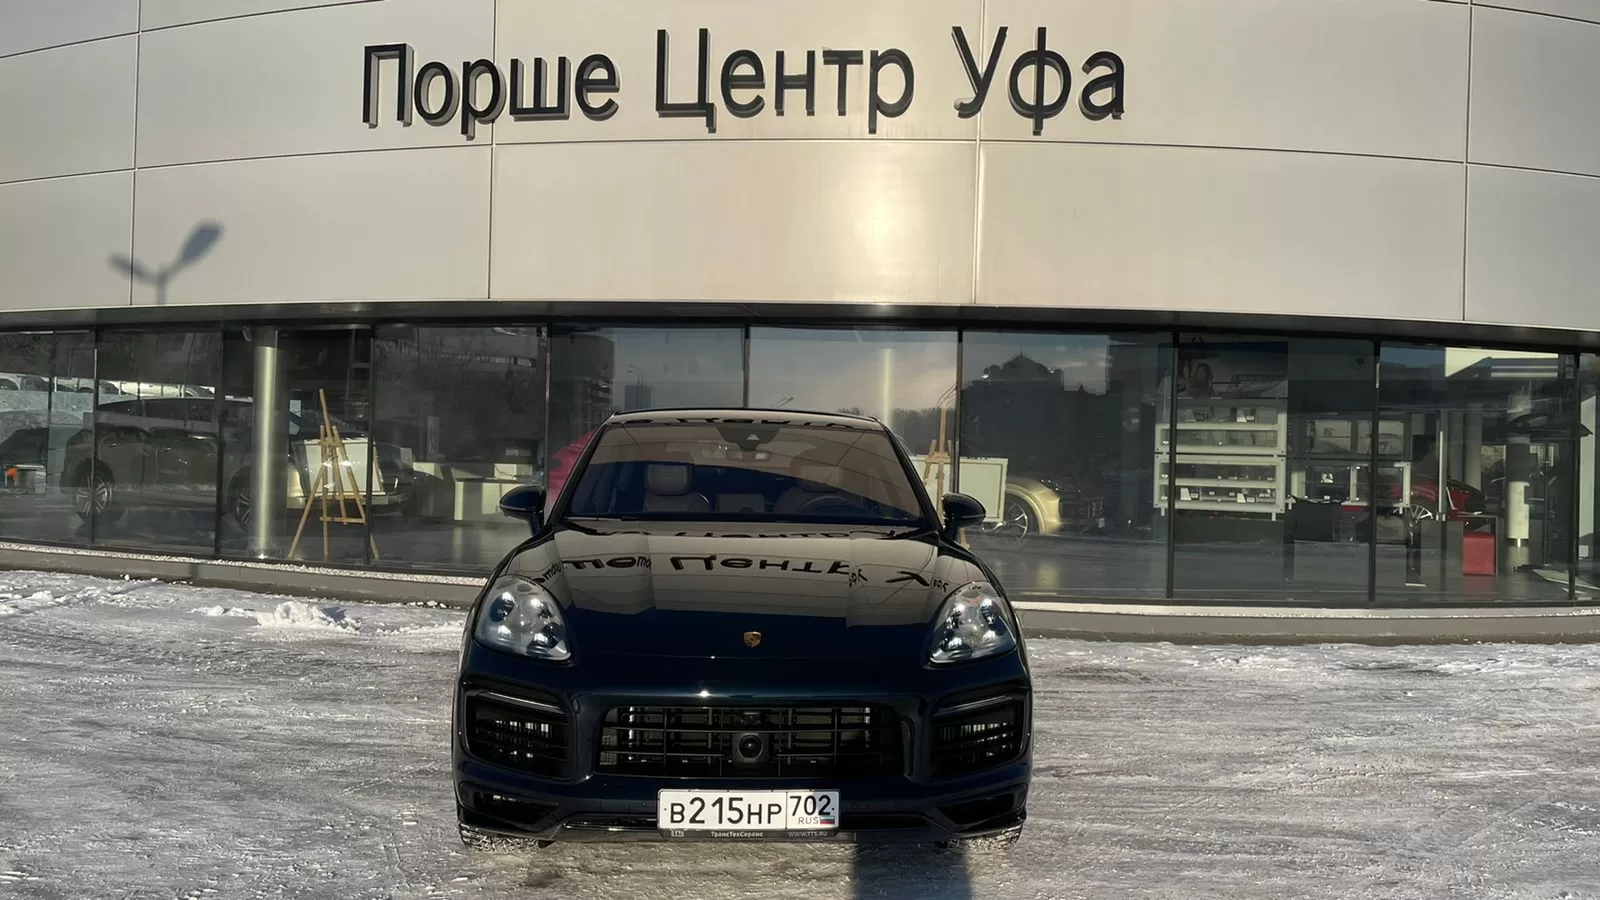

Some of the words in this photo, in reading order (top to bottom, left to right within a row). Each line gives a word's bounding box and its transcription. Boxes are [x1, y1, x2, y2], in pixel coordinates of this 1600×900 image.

[362, 42, 620, 141] Порше
[655, 27, 915, 135] Центр
[951, 25, 1125, 137] Уфа
[789, 794, 832, 816] 702
[798, 816, 819, 825] RUS
